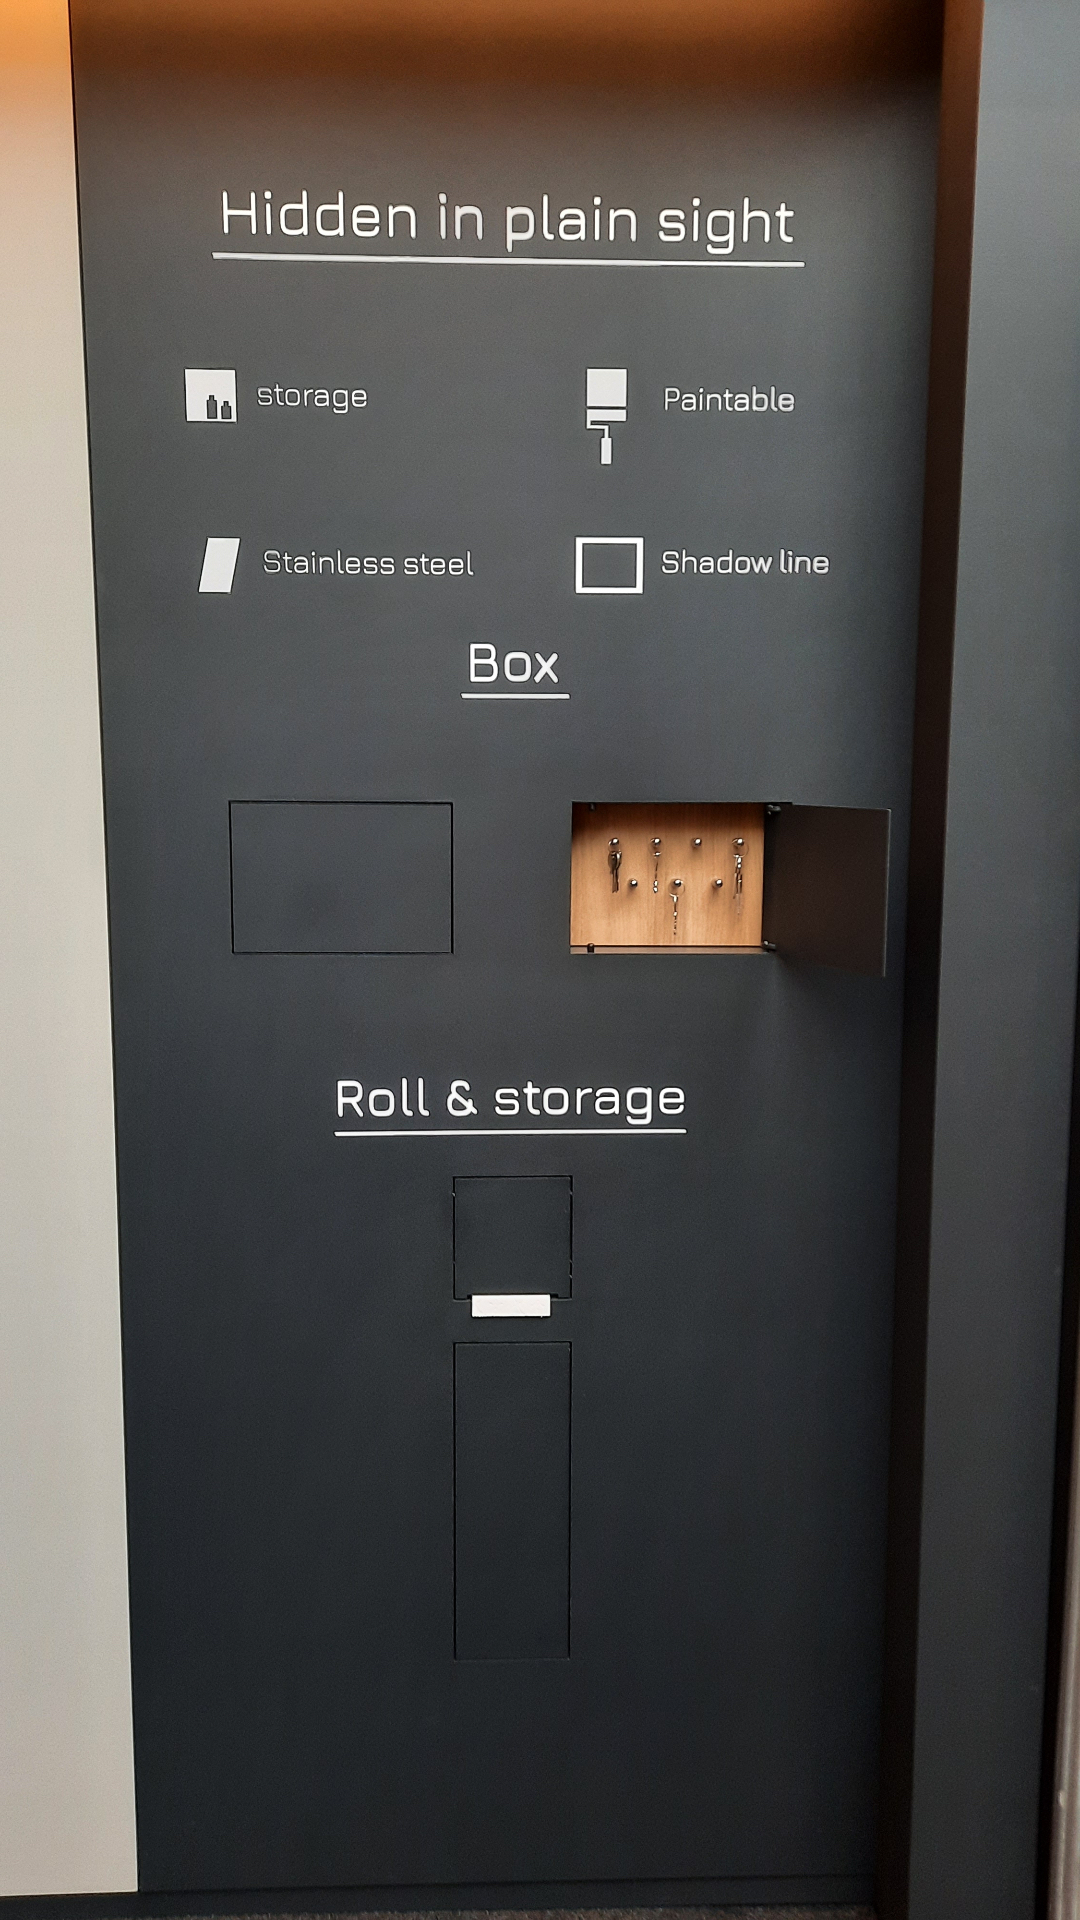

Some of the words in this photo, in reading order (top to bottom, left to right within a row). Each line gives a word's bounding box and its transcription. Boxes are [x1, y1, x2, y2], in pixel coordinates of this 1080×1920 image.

[220, 189, 417, 239] Hidden
[437, 193, 483, 240] in
[506, 193, 638, 252] plain
[658, 197, 795, 256] sight
[257, 384, 368, 414] storage
[663, 386, 796, 413] Paintable
[262, 549, 395, 575] Stainless
[403, 551, 474, 576] steel
[660, 549, 772, 575] Shadow
[779, 549, 831, 575] line
[469, 643, 559, 684] Box
[337, 1078, 430, 1117] Roll
[446, 1079, 477, 1117] &
[494, 1080, 686, 1125] storage
